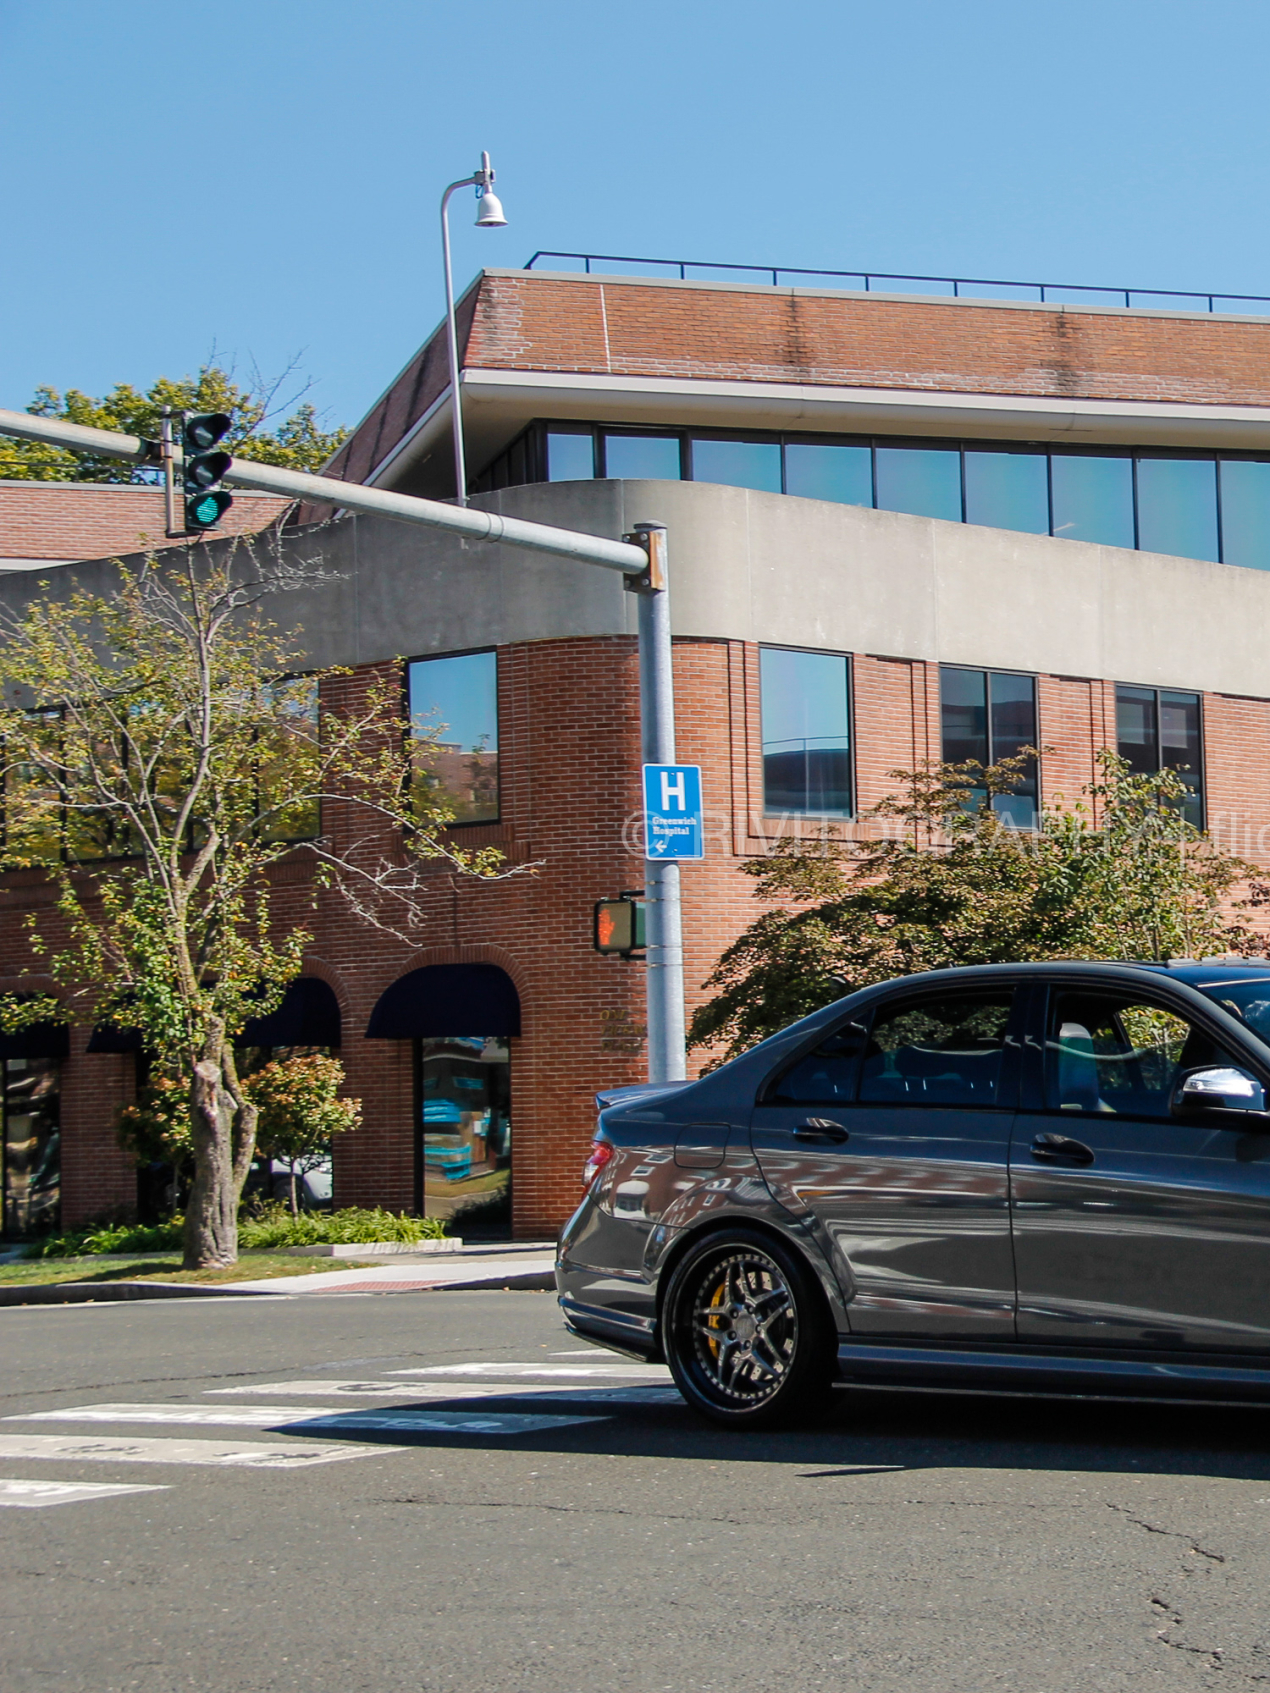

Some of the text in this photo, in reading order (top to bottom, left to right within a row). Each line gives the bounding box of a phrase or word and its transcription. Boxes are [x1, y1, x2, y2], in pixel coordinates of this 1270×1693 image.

[660, 771, 686, 811] H
[652, 816, 697, 825] Greenwich
[652, 826, 690, 837] Hospital
